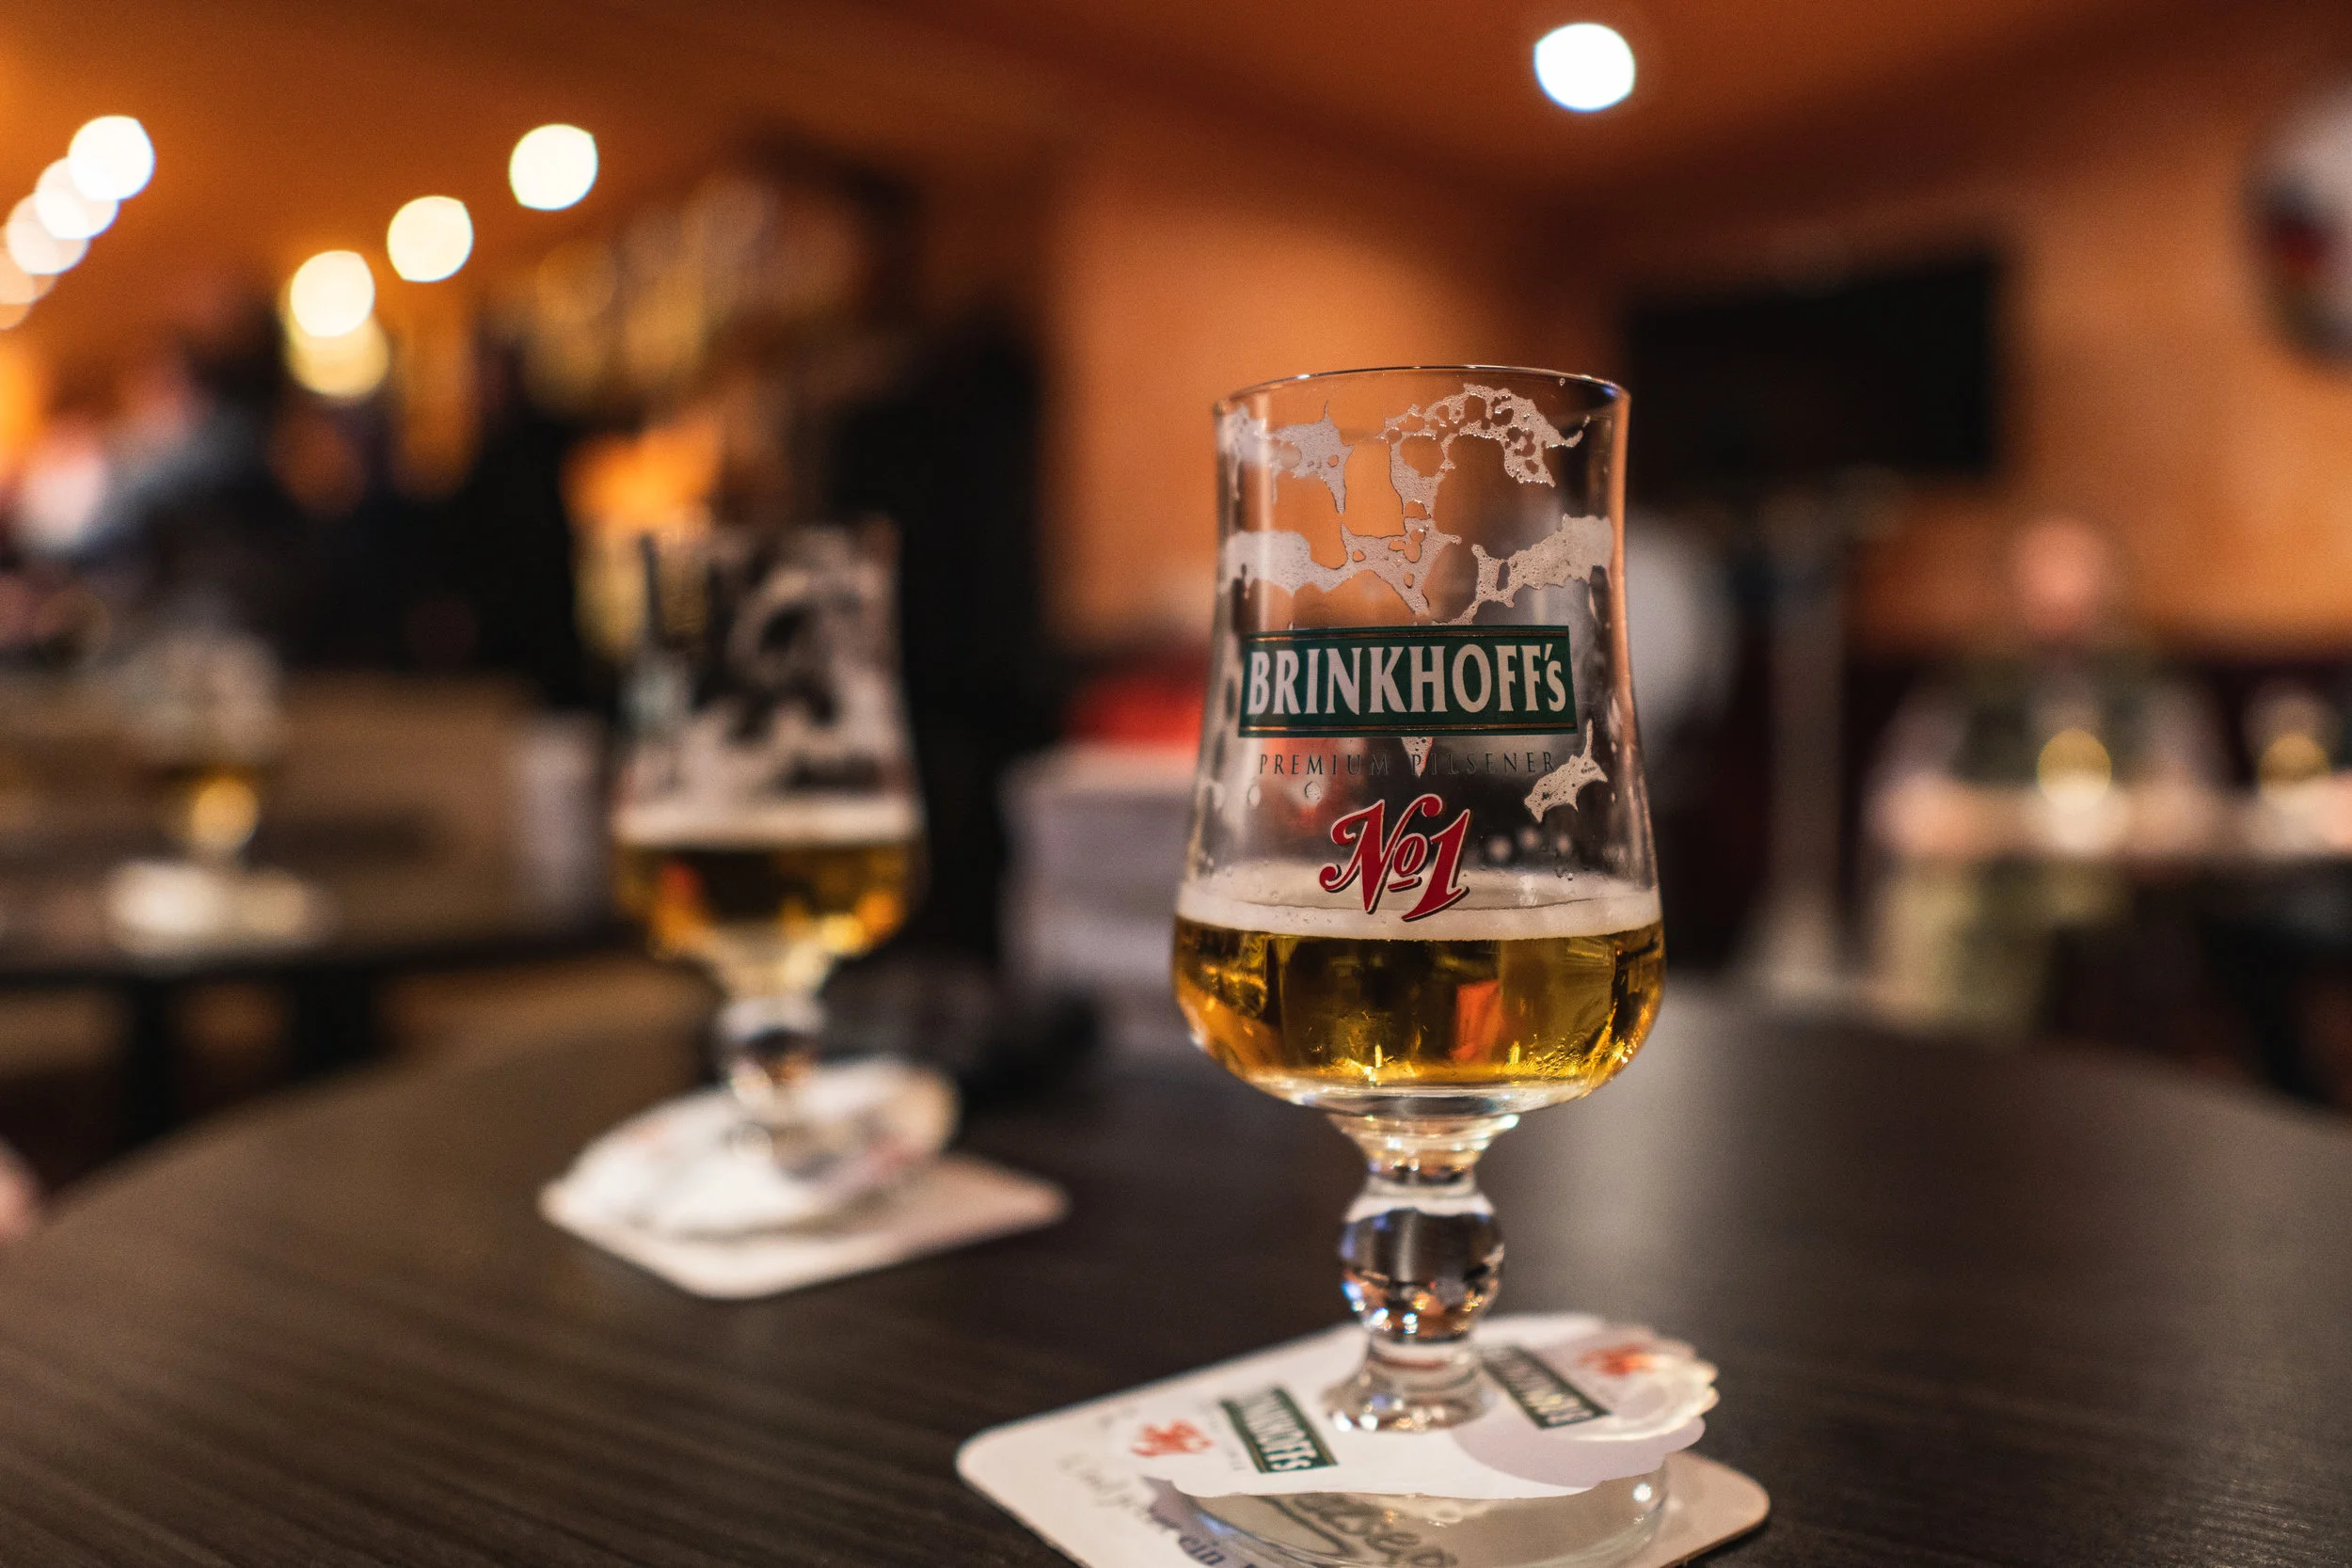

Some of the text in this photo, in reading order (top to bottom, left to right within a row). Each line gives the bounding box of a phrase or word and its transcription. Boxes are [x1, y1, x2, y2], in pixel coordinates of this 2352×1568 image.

[1247, 643, 1566, 715] BRINKHOFF's
[1259, 752, 1555, 776] PREMIUM PILSENER
